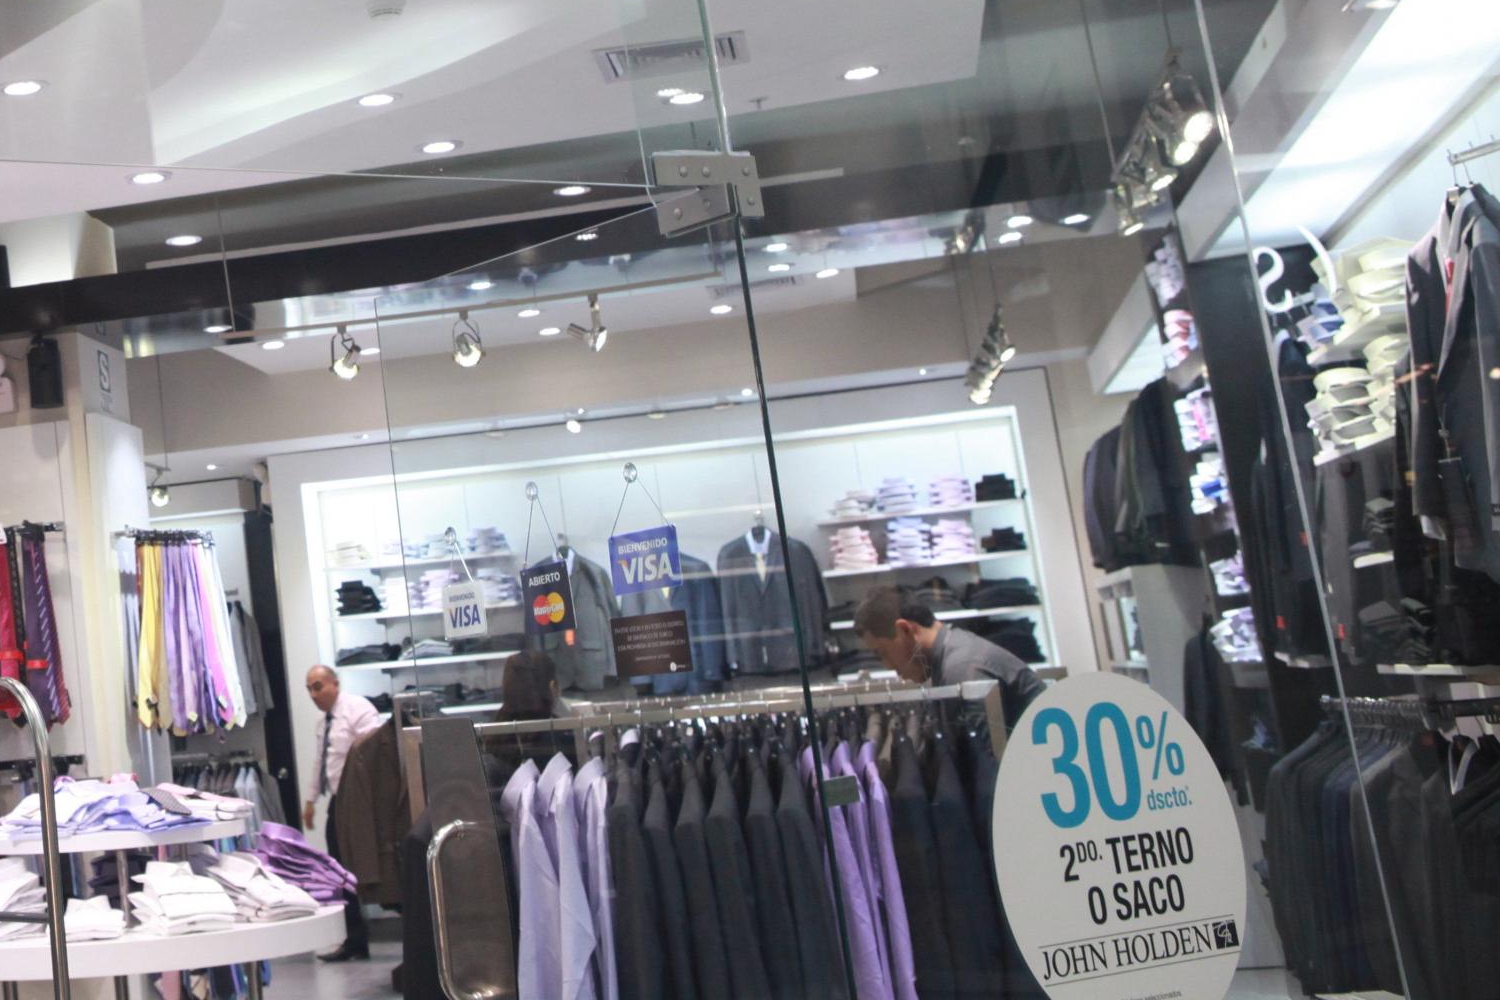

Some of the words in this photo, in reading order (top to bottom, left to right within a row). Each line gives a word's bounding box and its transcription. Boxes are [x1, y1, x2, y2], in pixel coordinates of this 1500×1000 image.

[618, 537, 668, 555] BIENVENIDO
[529, 571, 560, 587] ABIERTO
[617, 552, 674, 584] VISA
[449, 604, 481, 628] VISA
[1031, 701, 1185, 829] 30%
[1105, 827, 1194, 875] TERNO
[1113, 873, 1186, 921] SACO
[1042, 941, 1109, 981] JOHN
[1112, 923, 1213, 968] HOLDEN
